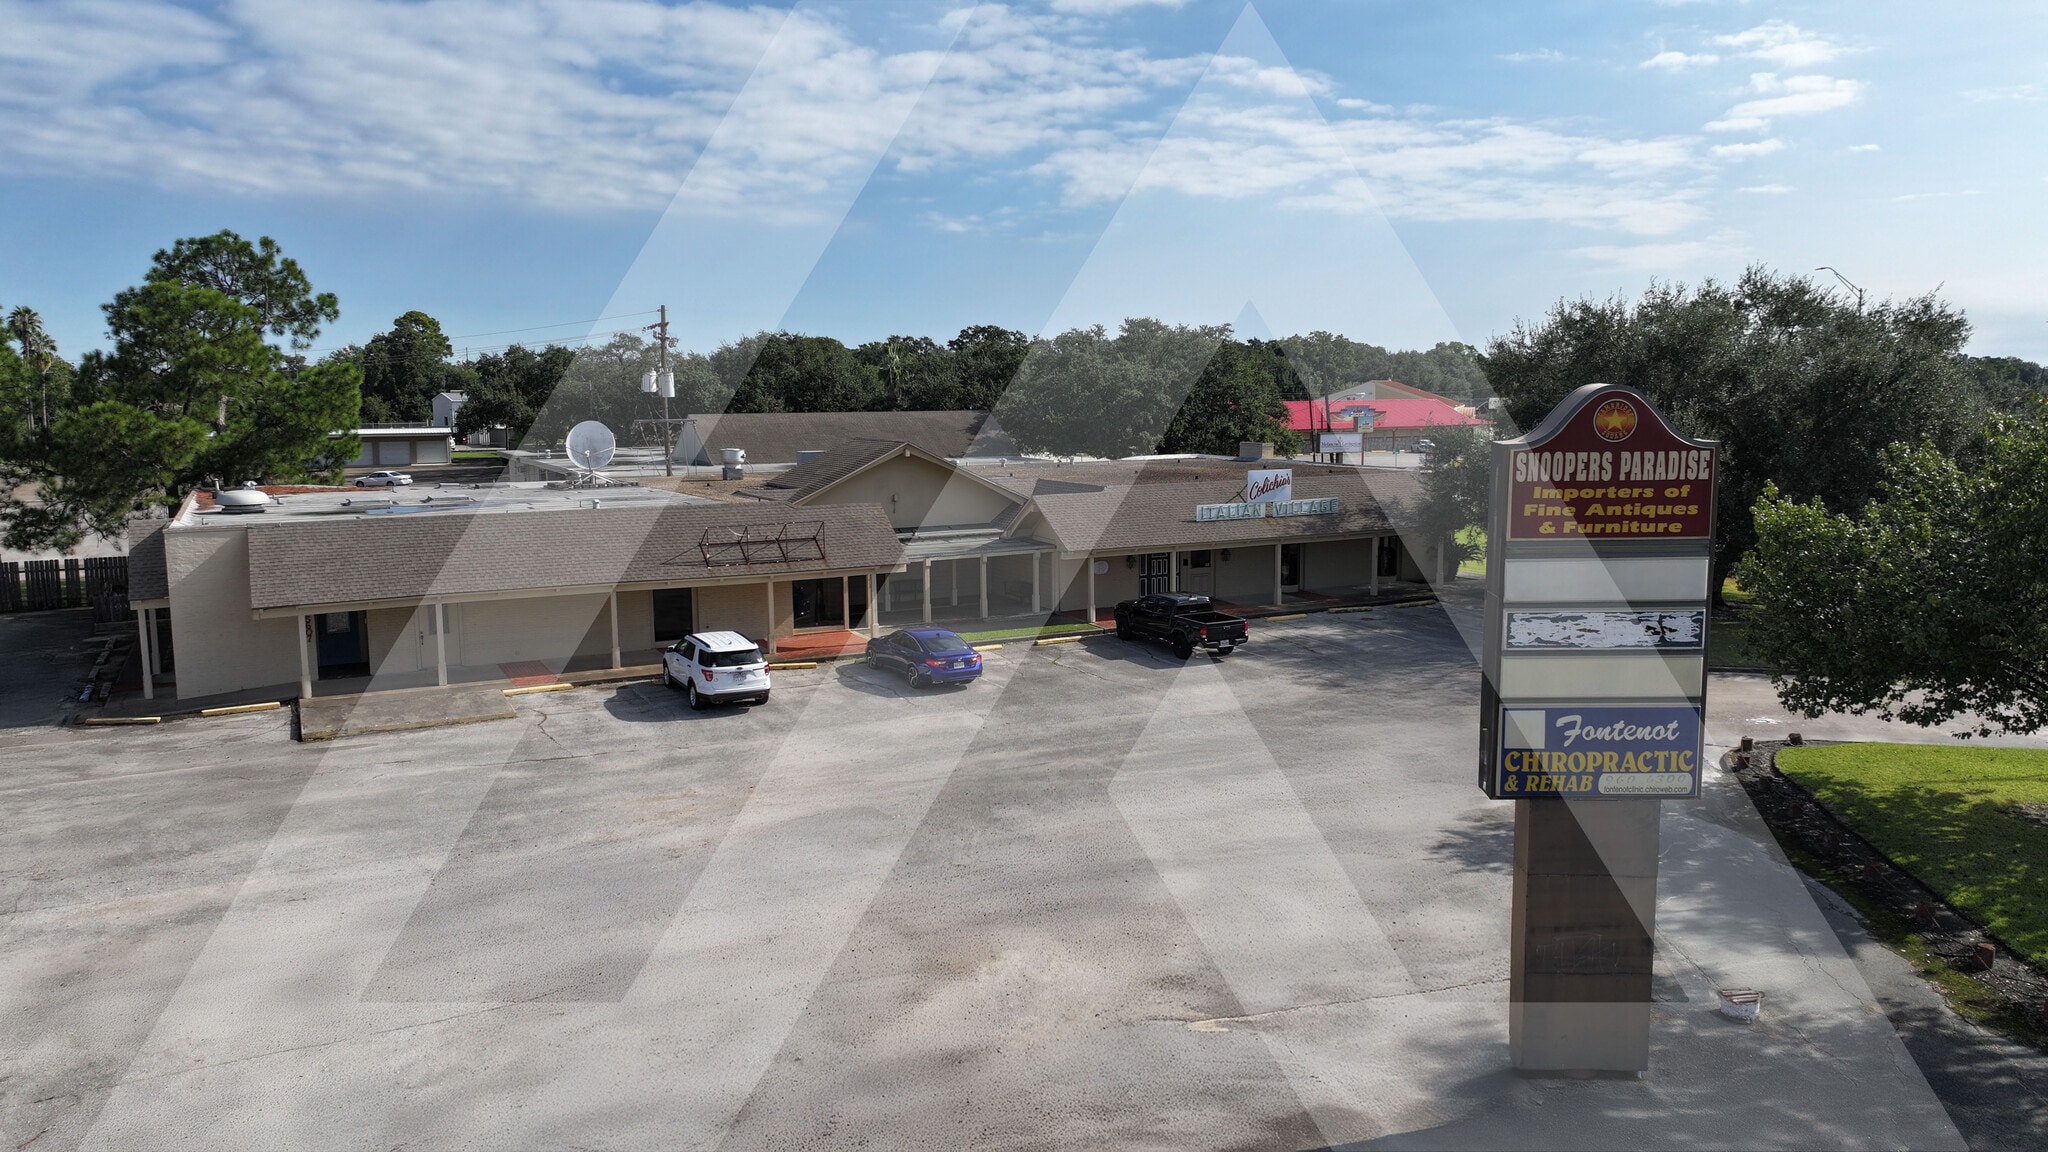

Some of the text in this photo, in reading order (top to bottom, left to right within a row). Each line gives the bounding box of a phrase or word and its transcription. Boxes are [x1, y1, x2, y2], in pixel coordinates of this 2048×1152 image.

[1515, 450, 1711, 482] SNOOPERS PARADISE
[1533, 484, 1691, 502] Importers of
[1200, 498, 1338, 520] ITALIAN VILLAGE
[1523, 502, 1699, 518] Fine Antiques
[1538, 520, 1683, 534] & Furniture
[1555, 714, 1680, 748] Fontenot
[1504, 750, 1694, 773] CHIROPRACTIC
[1504, 774, 1593, 792] & REHAB
